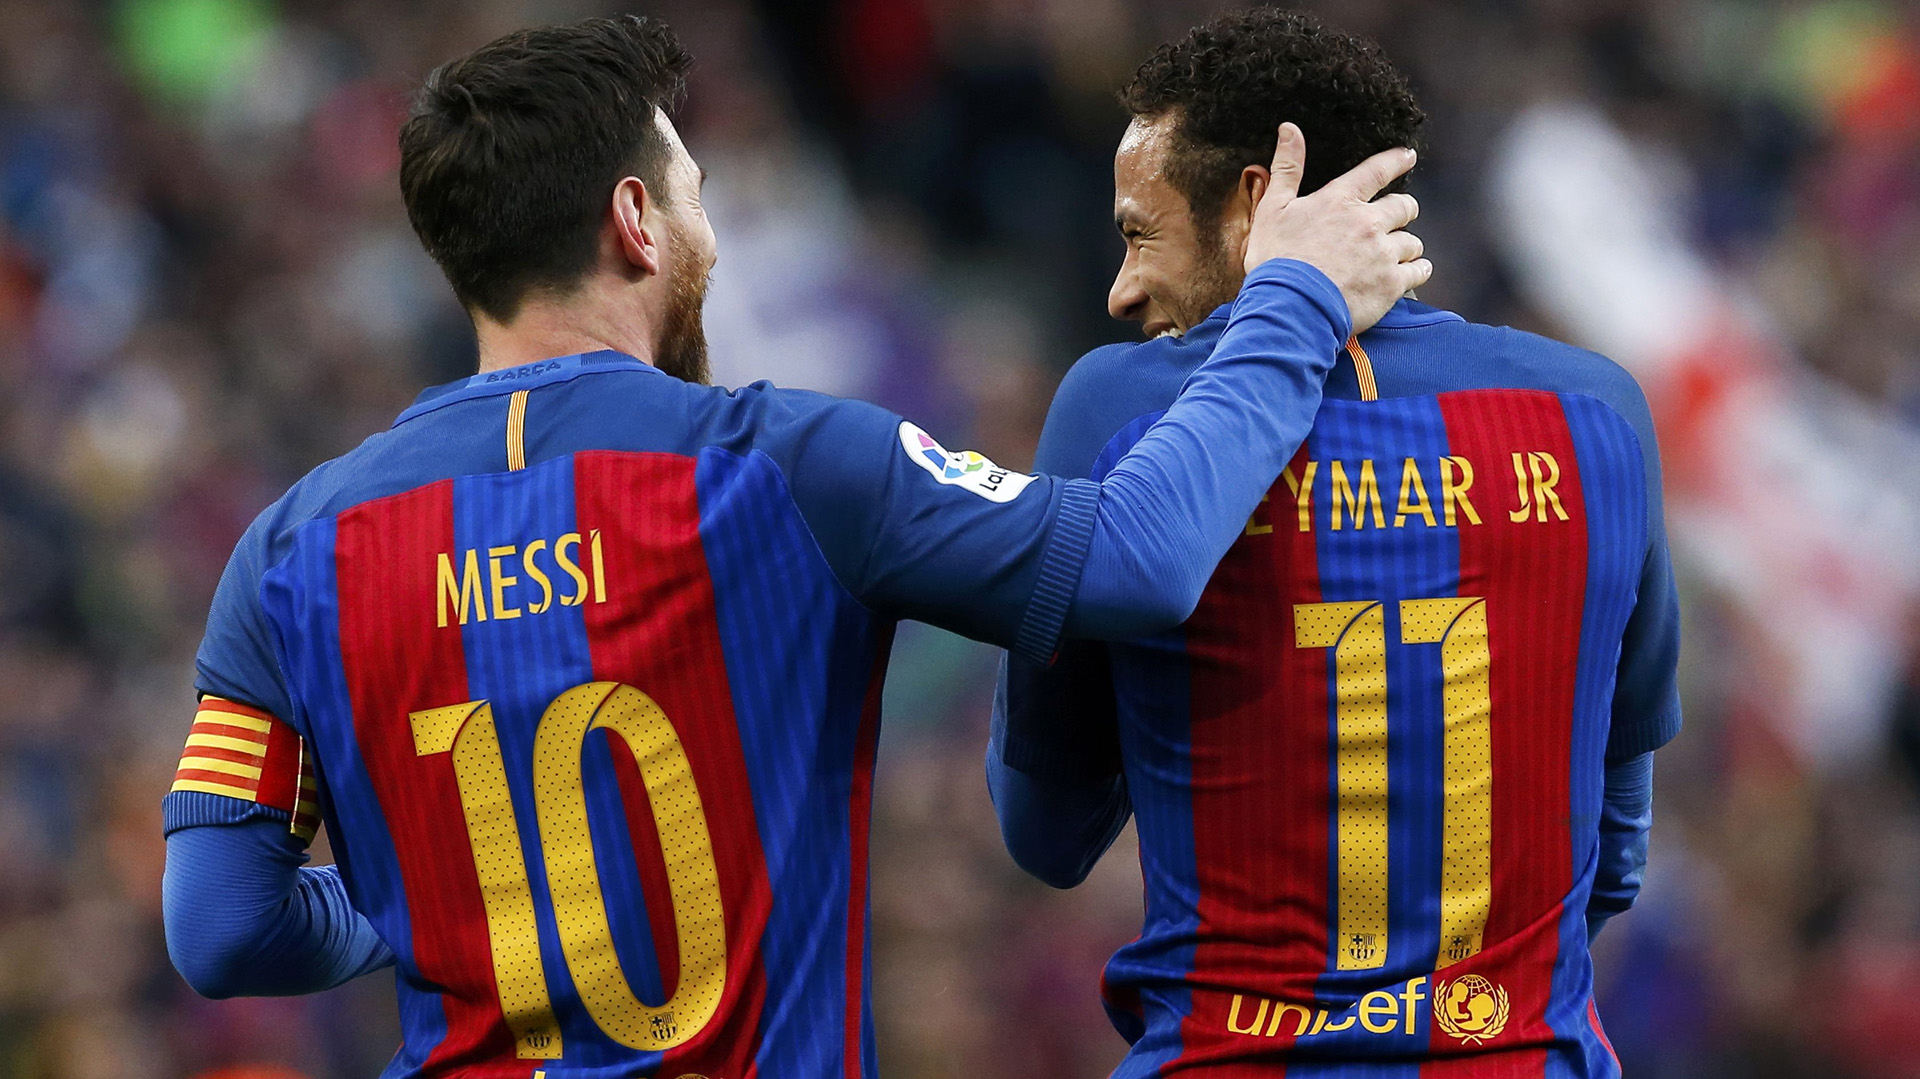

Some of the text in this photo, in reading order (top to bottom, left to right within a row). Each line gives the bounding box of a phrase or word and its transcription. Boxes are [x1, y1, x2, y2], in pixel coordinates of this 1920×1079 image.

[1509, 451, 1570, 523] JR
[436, 529, 606, 628] MESSI
[1293, 597, 1491, 971] 11
[409, 681, 727, 1060] 10
[1227, 976, 1426, 1037] unicef
